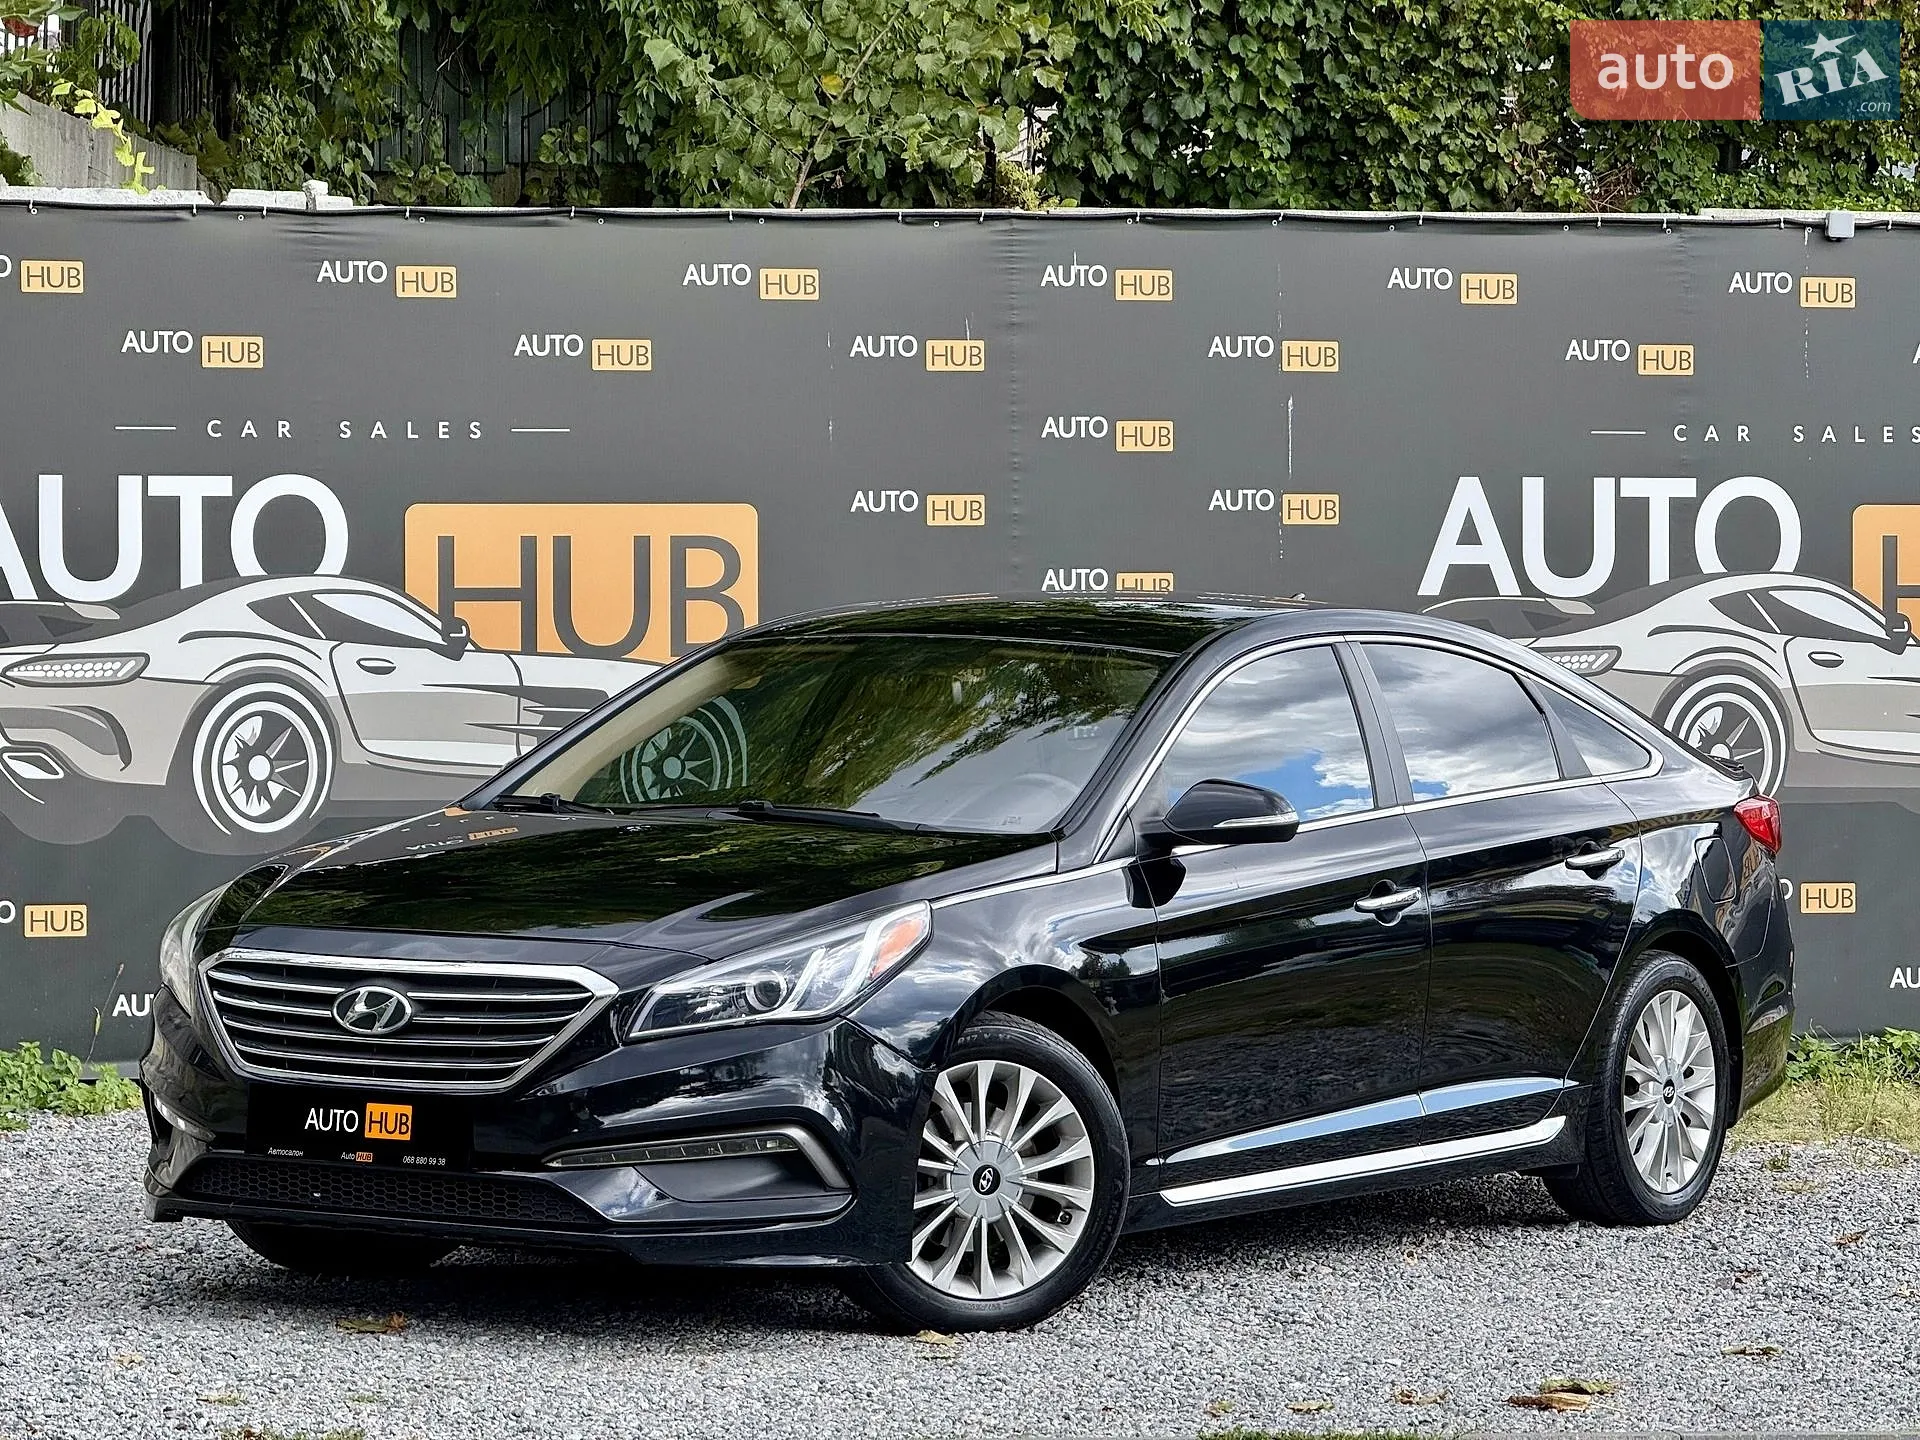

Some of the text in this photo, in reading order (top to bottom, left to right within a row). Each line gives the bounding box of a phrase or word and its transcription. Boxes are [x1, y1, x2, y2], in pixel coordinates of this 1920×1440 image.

[27, 266, 81, 288] HUB
[317, 261, 454, 293] AUTO HUB
[683, 264, 817, 295] AUTO HUB
[1041, 265, 1171, 296] AUTO HUB
[1387, 268, 1515, 299] AUTO HUB
[1729, 272, 1853, 303] AUTO HUB
[121, 331, 261, 363] AUTO HUB
[514, 334, 650, 366] AUTO HUB
[850, 335, 983, 366] AUTO HUB
[1208, 336, 1337, 367] AUTO HUB
[1565, 339, 1692, 371] AUTO HUB
[207, 420, 482, 439] CAR SALES
[1041, 416, 1171, 447] AUTO HUB
[1674, 425, 1920, 443] CAR SALES
[851, 490, 983, 521] AUTO HUB
[1208, 489, 1337, 520] AUTO HUB
[1417, 476, 1801, 598] AUTO
[1041, 569, 1108, 591] AUTO
[438, 535, 745, 657] HUB
[1805, 888, 1854, 908] HUB
[30, 911, 84, 932] HUB
[305, 1108, 409, 1135] AUTO HUB
[268, 1147, 303, 1157] Автосалон
[341, 1152, 372, 1161] Auto HUB
[403, 1156, 446, 1166] 068 880 99 38
